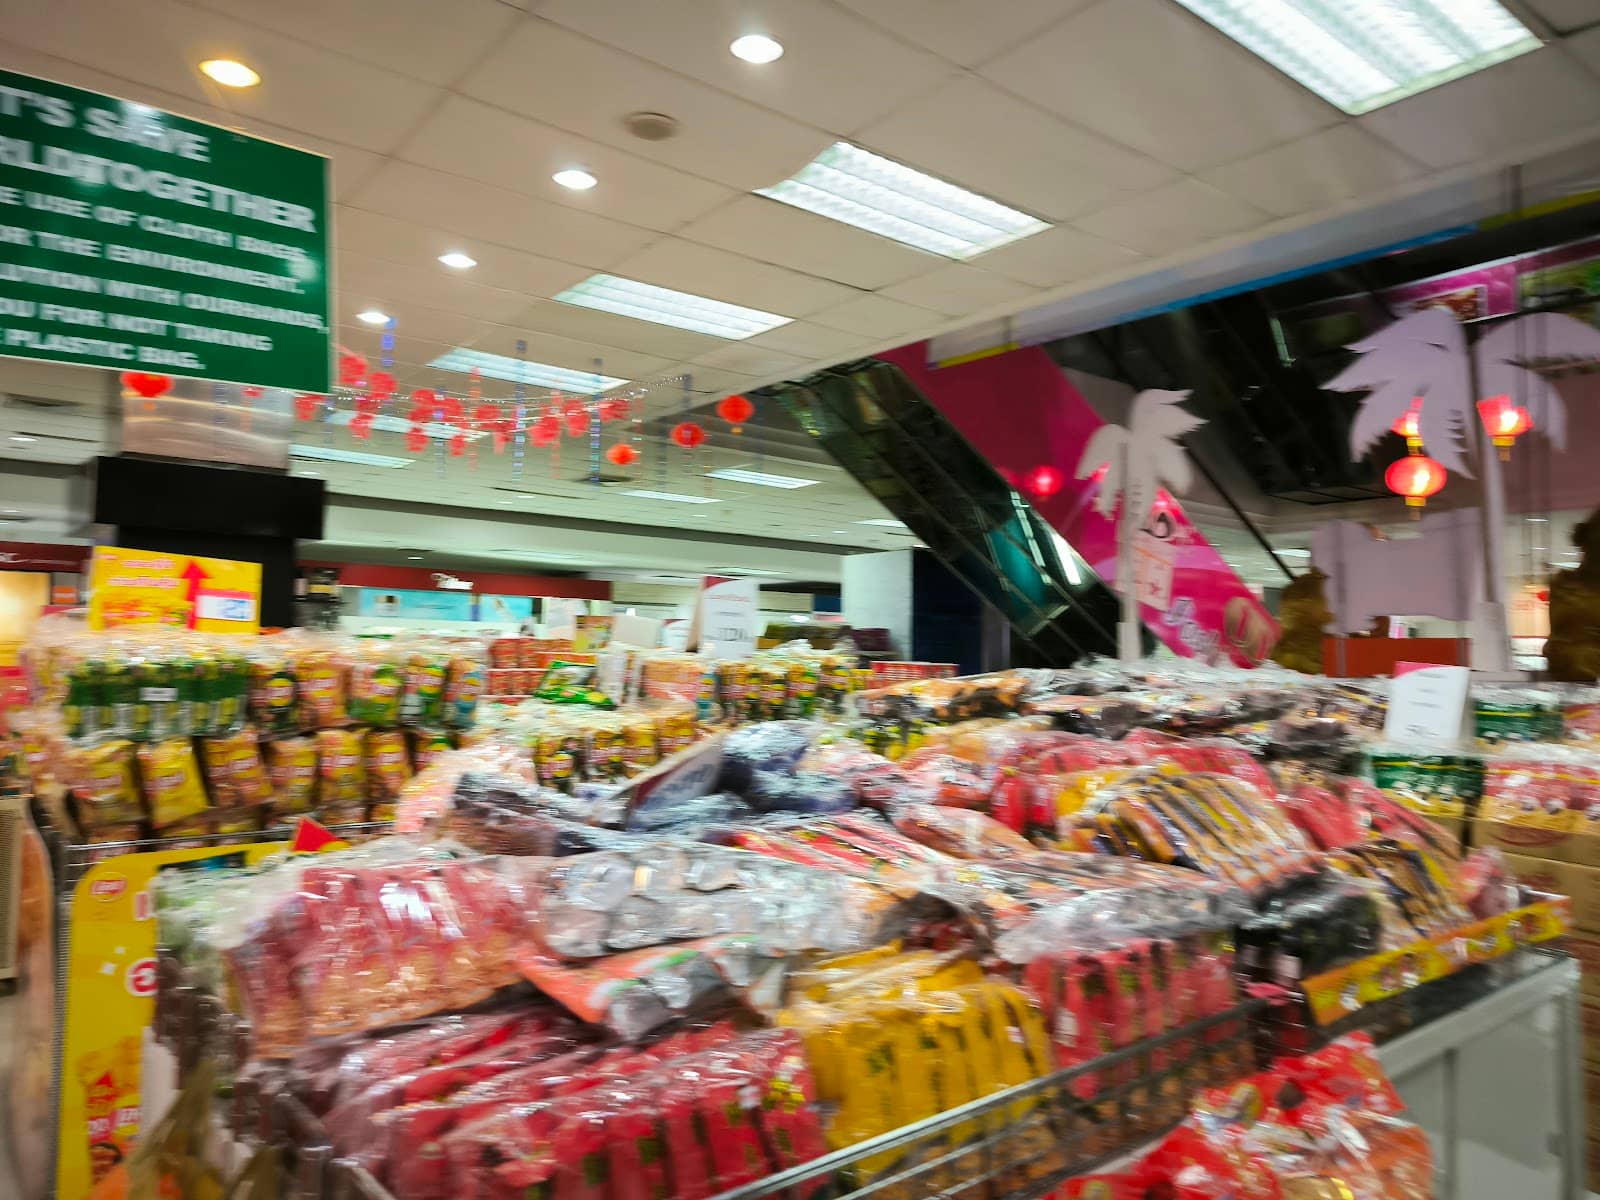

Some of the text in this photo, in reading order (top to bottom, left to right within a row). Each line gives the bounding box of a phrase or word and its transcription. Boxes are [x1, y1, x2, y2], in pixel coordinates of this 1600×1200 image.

[74, 150, 318, 234] TOGETHER
[92, 205, 138, 227] OF
[138, 214, 233, 248] CLOTH
[37, 231, 103, 259] THE
[38, 302, 105, 328] FOR
[106, 312, 168, 337] NOT
[4, 328, 137, 361] PLASTIC
